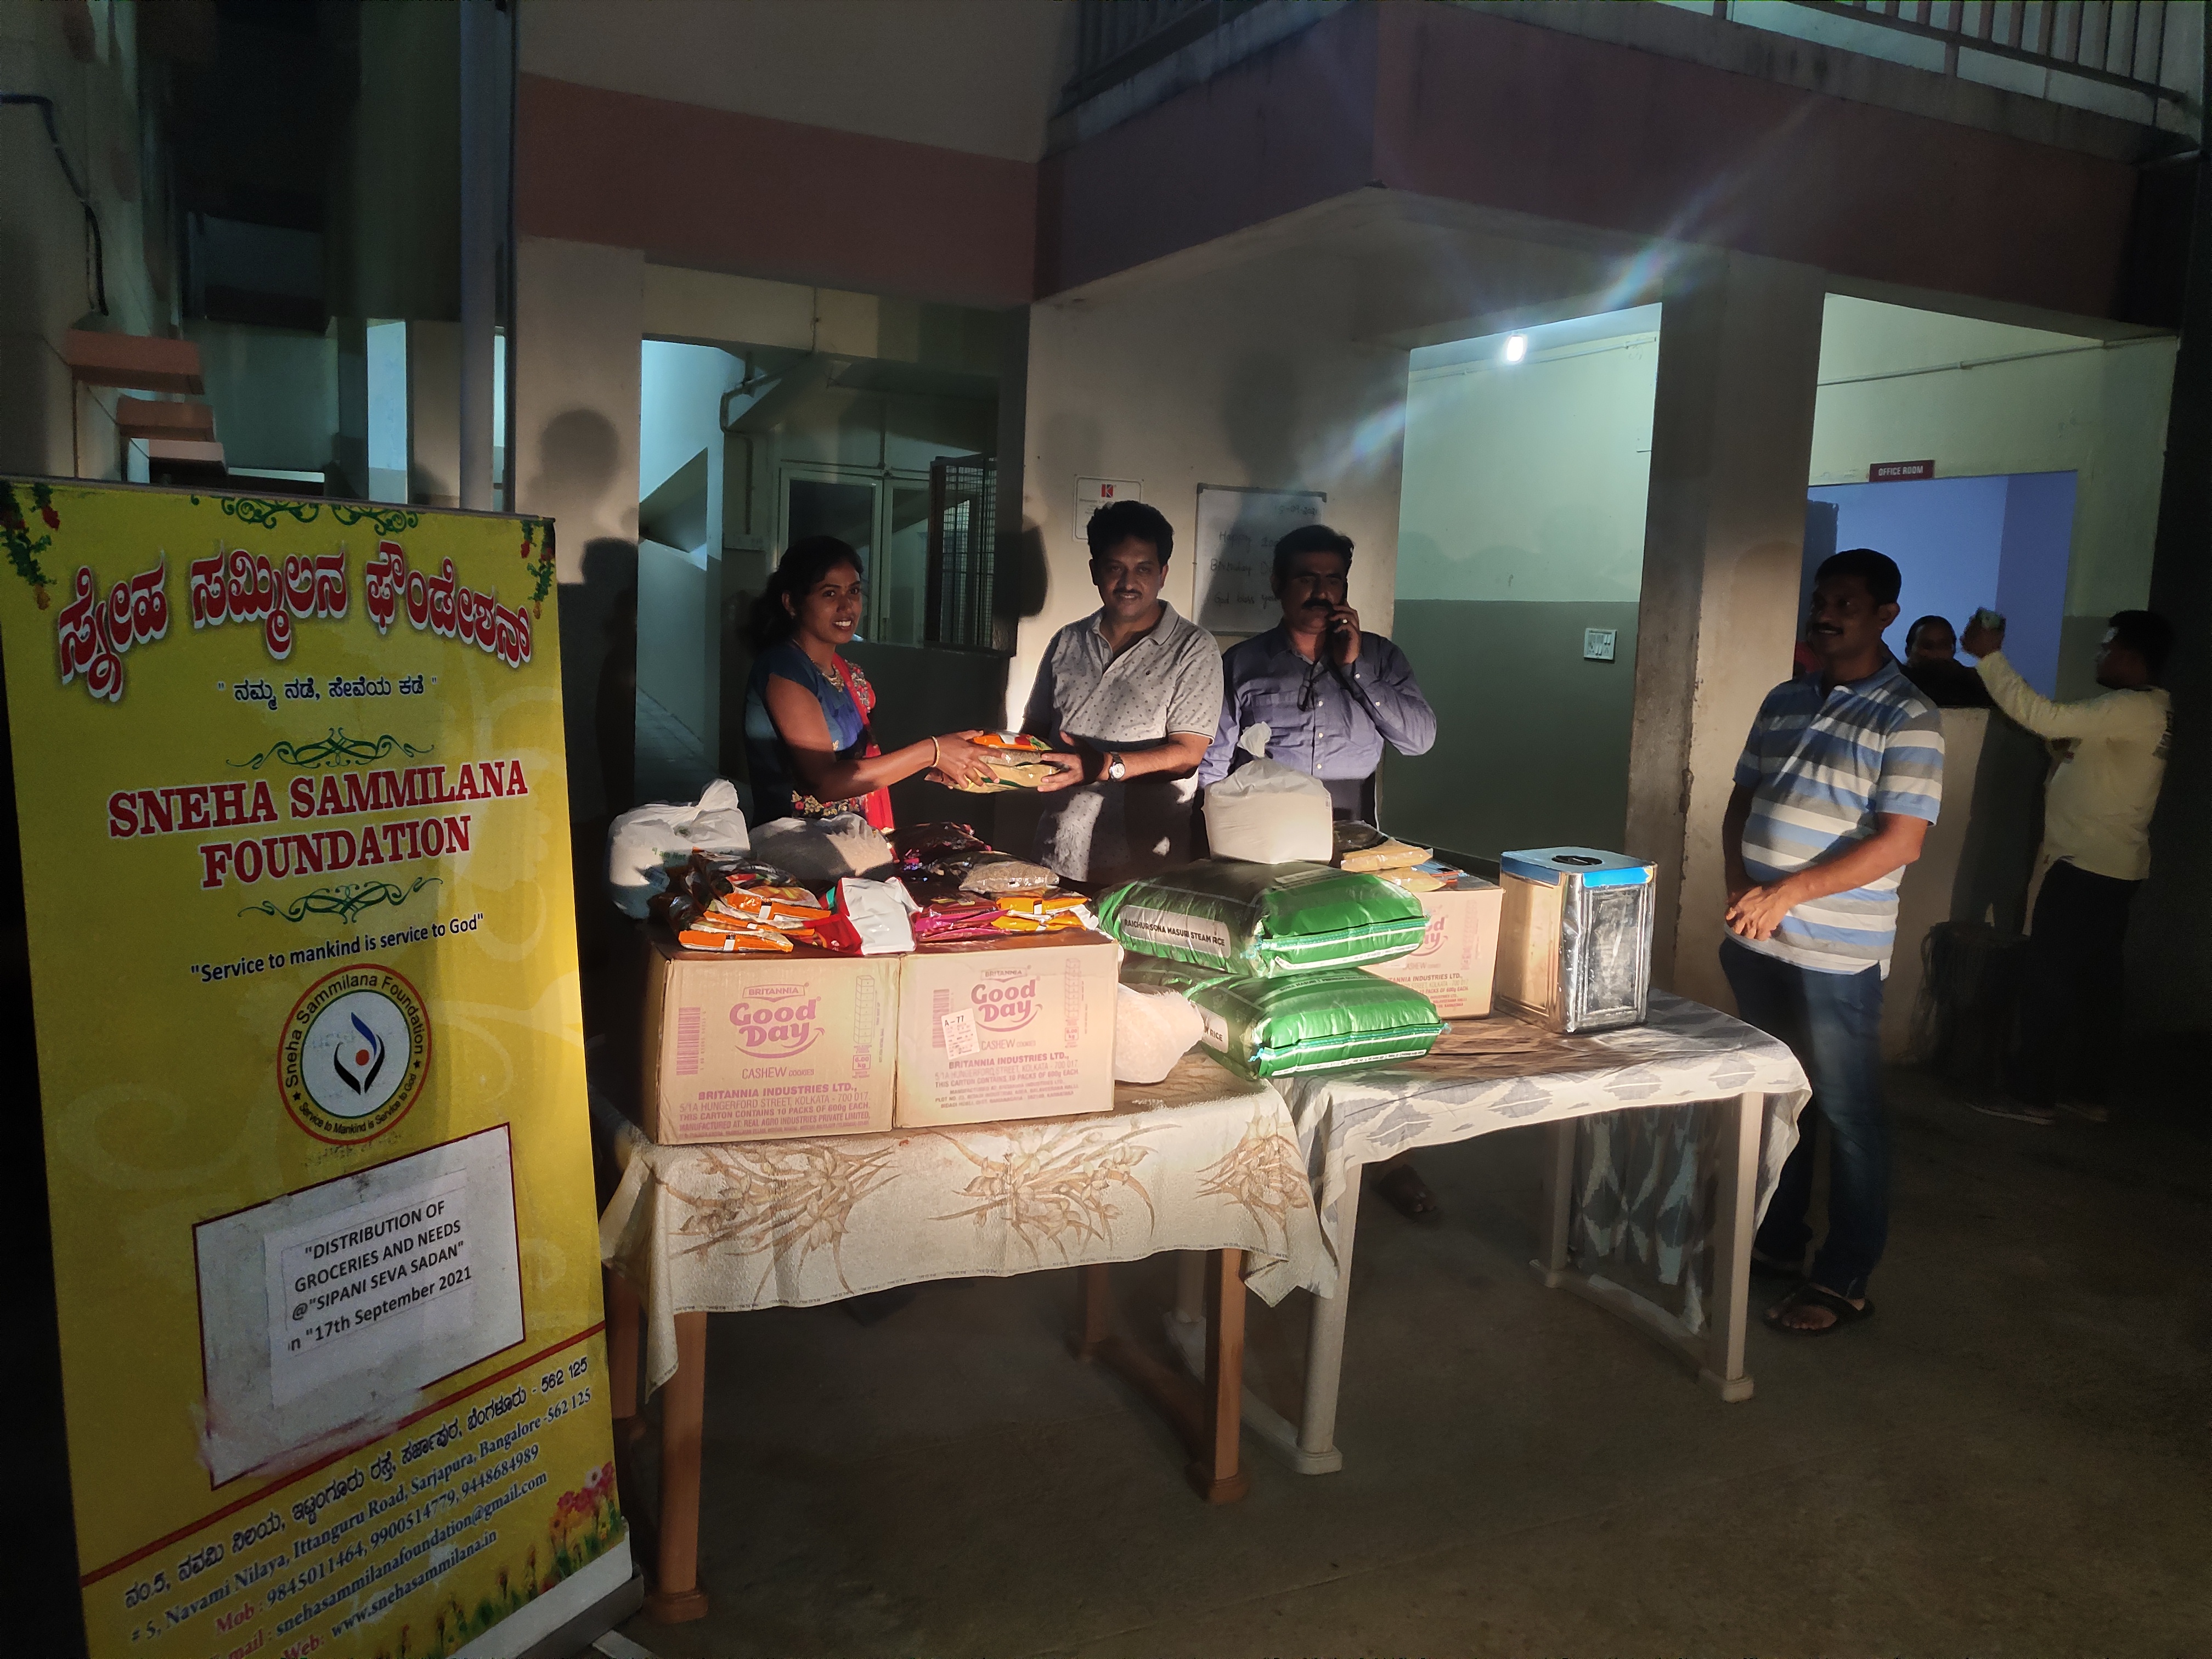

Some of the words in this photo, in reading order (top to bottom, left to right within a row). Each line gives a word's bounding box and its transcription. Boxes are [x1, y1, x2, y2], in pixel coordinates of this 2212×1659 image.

[1878, 467, 1900, 476] OFFICE
[1903, 466, 1923, 474] ROOM
[1220, 531, 1250, 553] Happy
[1210, 558, 1250, 575] Birthday
[58, 550, 168, 703] ಸ್ನೇಹ
[191, 543, 347, 659] ಸಮ್ಮಿಲನ
[234, 679, 276, 710] ನಮ್ಮ
[284, 678, 320, 701] ನಡೆ,
[329, 676, 391, 698] ಸೇವೆಯ
[399, 674, 424, 695] ಕಡೆ
[109, 781, 278, 838] SNEHA
[290, 760, 528, 818] SAMMILANA
[200, 816, 471, 889] FOUNDATION
[1125, 919, 1149, 930] RAICHUR
[1149, 923, 1166, 934] SONA
[1167, 928, 1190, 938] MASURI
[1191, 932, 1211, 943] STEAM
[191, 958, 264, 983] "Service
[268, 953, 285, 968] to
[290, 936, 360, 964] mankind
[364, 935, 376, 951] is
[380, 926, 428, 947] service
[431, 923, 445, 937] to
[449, 913, 484, 934] God"
[1413, 973, 1448, 982] INDUSTRIES
[971, 979, 1036, 1004] Good
[730, 999, 816, 1026] Good
[978, 1000, 1031, 1023] Day
[285, 1030, 302, 1088] Sneha
[296, 974, 377, 1024] Sammilana
[382, 976, 425, 1054] Foundation
[739, 1022, 810, 1048] Day
[1210, 1029, 1222, 1042] RICE
[981, 1039, 1015, 1051] CASHEW
[742, 1066, 787, 1079] CASHEW
[789, 1068, 814, 1077] COOKIES
[949, 1058, 995, 1069] BRITANNIA
[997, 1053, 1047, 1065] INDUSTRIES
[1022, 1062, 1048, 1072] KOLKATA
[698, 1088, 759, 1100] BRITANNIA
[763, 1084, 829, 1097] INDUSTRIES
[833, 1082, 857, 1092] LTD.,
[951, 1078, 975, 1087] CARTON
[977, 1075, 1007, 1084] CONTAINS
[299, 1101, 324, 1127] Service
[323, 1121, 332, 1131] to
[334, 1122, 366, 1134] Mankind
[375, 1100, 401, 1124] Service
[399, 1091, 408, 1102] to
[404, 1073, 417, 1092] God
[680, 1113, 697, 1121] THIS
[700, 1111, 733, 1120] CARTON
[735, 1109, 775, 1118] CONTAINS
[789, 1106, 814, 1114] PACKS
[816, 1104, 826, 1113] OF
[701, 1098, 758, 1111] HUNGERFORD
[760, 1097, 792, 1108] STREET,
[795, 1094, 830, 1105] KOLKATA
[838, 1093, 852, 1102] 700
[680, 1121, 731, 1131] MANUFACTURED
[744, 1119, 759, 1127] REAL
[761, 1118, 778, 1126] AGRO
[781, 1115, 817, 1125] INDUSTRIES
[819, 1113, 843, 1122] PRIVATE
[304, 1208, 421, 1260] "DISTRIBUTION
[426, 1200, 445, 1218] OF
[295, 1250, 379, 1293] GROCERIES
[383, 1238, 414, 1261] AND
[418, 1220, 461, 1248] NEEDS
[292, 1278, 366, 1322] @"SIPANI
[370, 1263, 408, 1289] SEVA
[411, 1240, 464, 1273] SADAN"
[306, 1316, 351, 1342] "17th
[355, 1281, 435, 1325] September
[439, 1266, 472, 1291] 2021
[467, 1386, 527, 1431] ಬೆಂಗಳೂರು
[541, 1369, 564, 1392] 562
[568, 1356, 588, 1378] 125
[166, 1579, 231, 1625] Navami
[235, 1556, 290, 1590] Nilaya,
[293, 1511, 365, 1558] Ittanguru
[368, 1485, 408, 1520] Road,
[411, 1453, 477, 1494] Sarjapura,
[479, 1417, 541, 1458] Bangalore
[572, 1387, 591, 1406] 125
[216, 1602, 255, 1634] Mob
[266, 1541, 367, 1607] 9845011464,
[370, 1487, 459, 1549] 9900514779,
[461, 1444, 539, 1497] 9448684989
[276, 1472, 548, 1637] snehasammilanafoundation@gmail.com
[331, 1530, 497, 1638] www.snehasammilana.in
